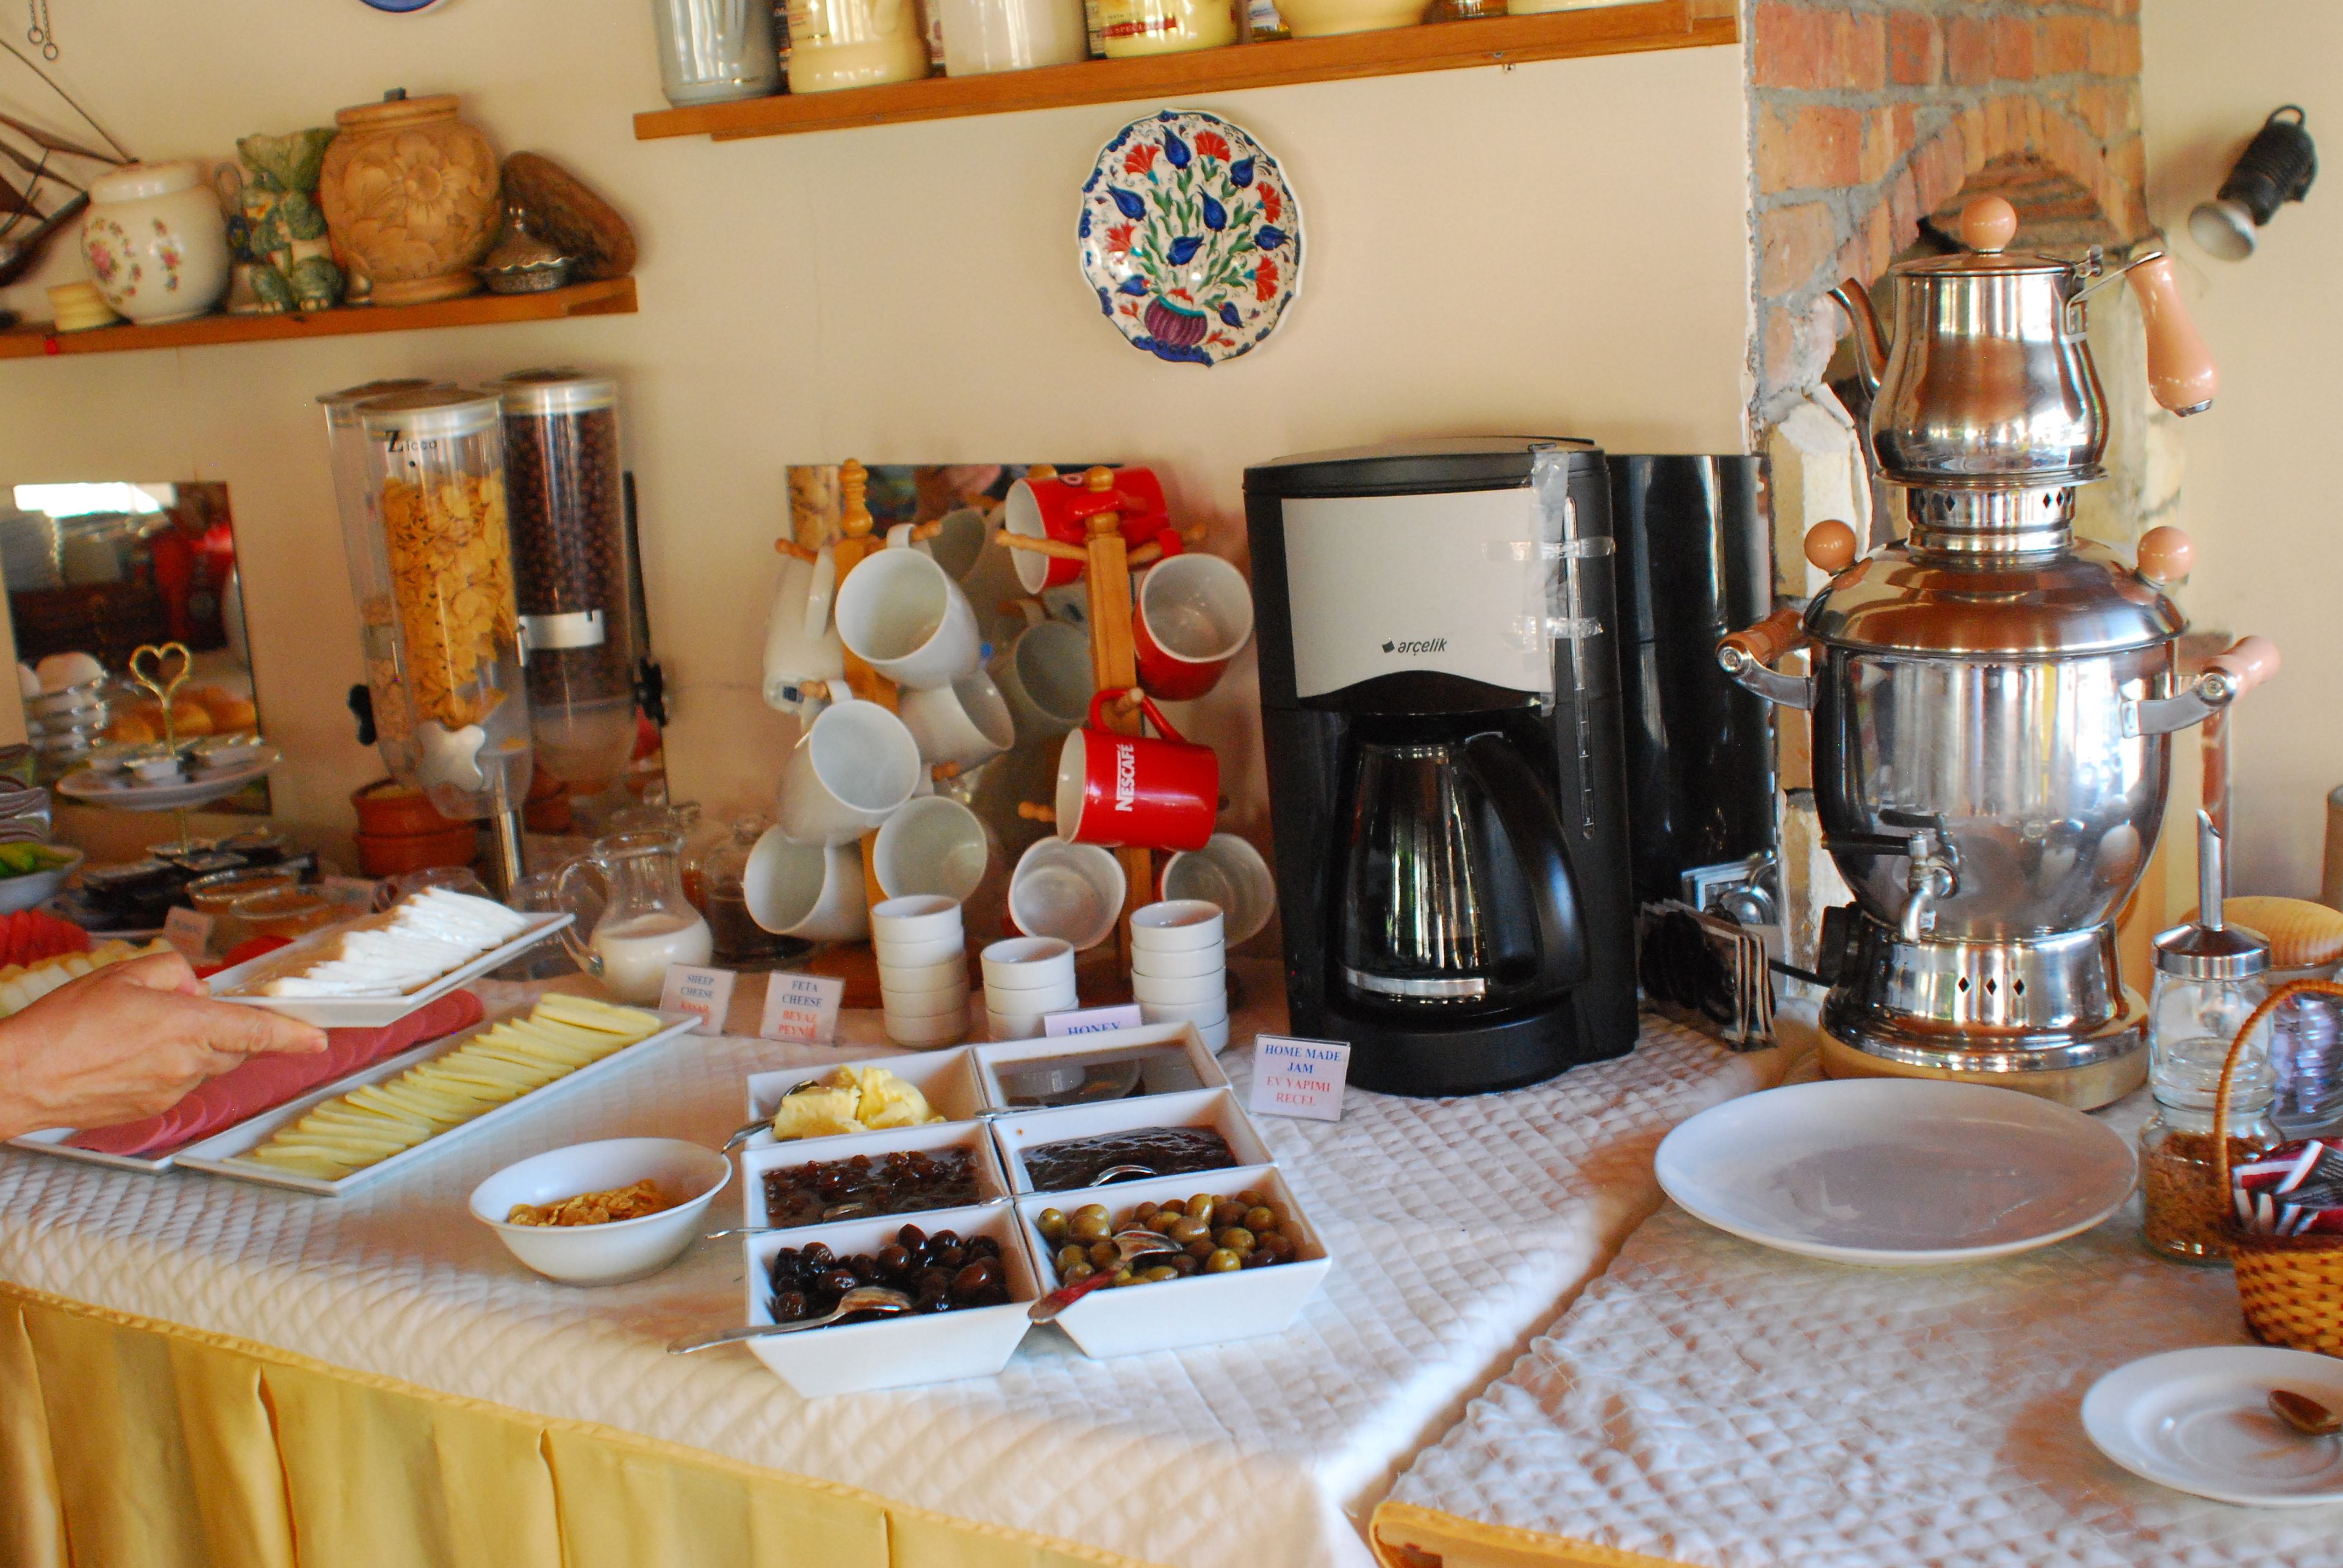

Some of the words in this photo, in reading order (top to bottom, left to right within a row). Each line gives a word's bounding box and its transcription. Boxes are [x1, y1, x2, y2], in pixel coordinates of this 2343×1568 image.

[385, 430, 438, 452] Zicco
[1397, 638, 1448, 655] arçelik
[1115, 744, 1135, 812] NESCAFÉ
[687, 974, 714, 986] SHEEP
[792, 980, 818, 992] FETA
[680, 985, 714, 999] CHEESE
[782, 994, 822, 1008] CHEESE
[782, 1009, 818, 1024] BEYAZ
[1265, 1044, 1303, 1057] HOME
[1305, 1048, 1342, 1062] MADE
[1287, 1062, 1314, 1074] JAM
[1266, 1076, 1283, 1086] EV
[1286, 1078, 1331, 1093] YAPIMI
[1276, 1092, 1317, 1106] REÇEL
